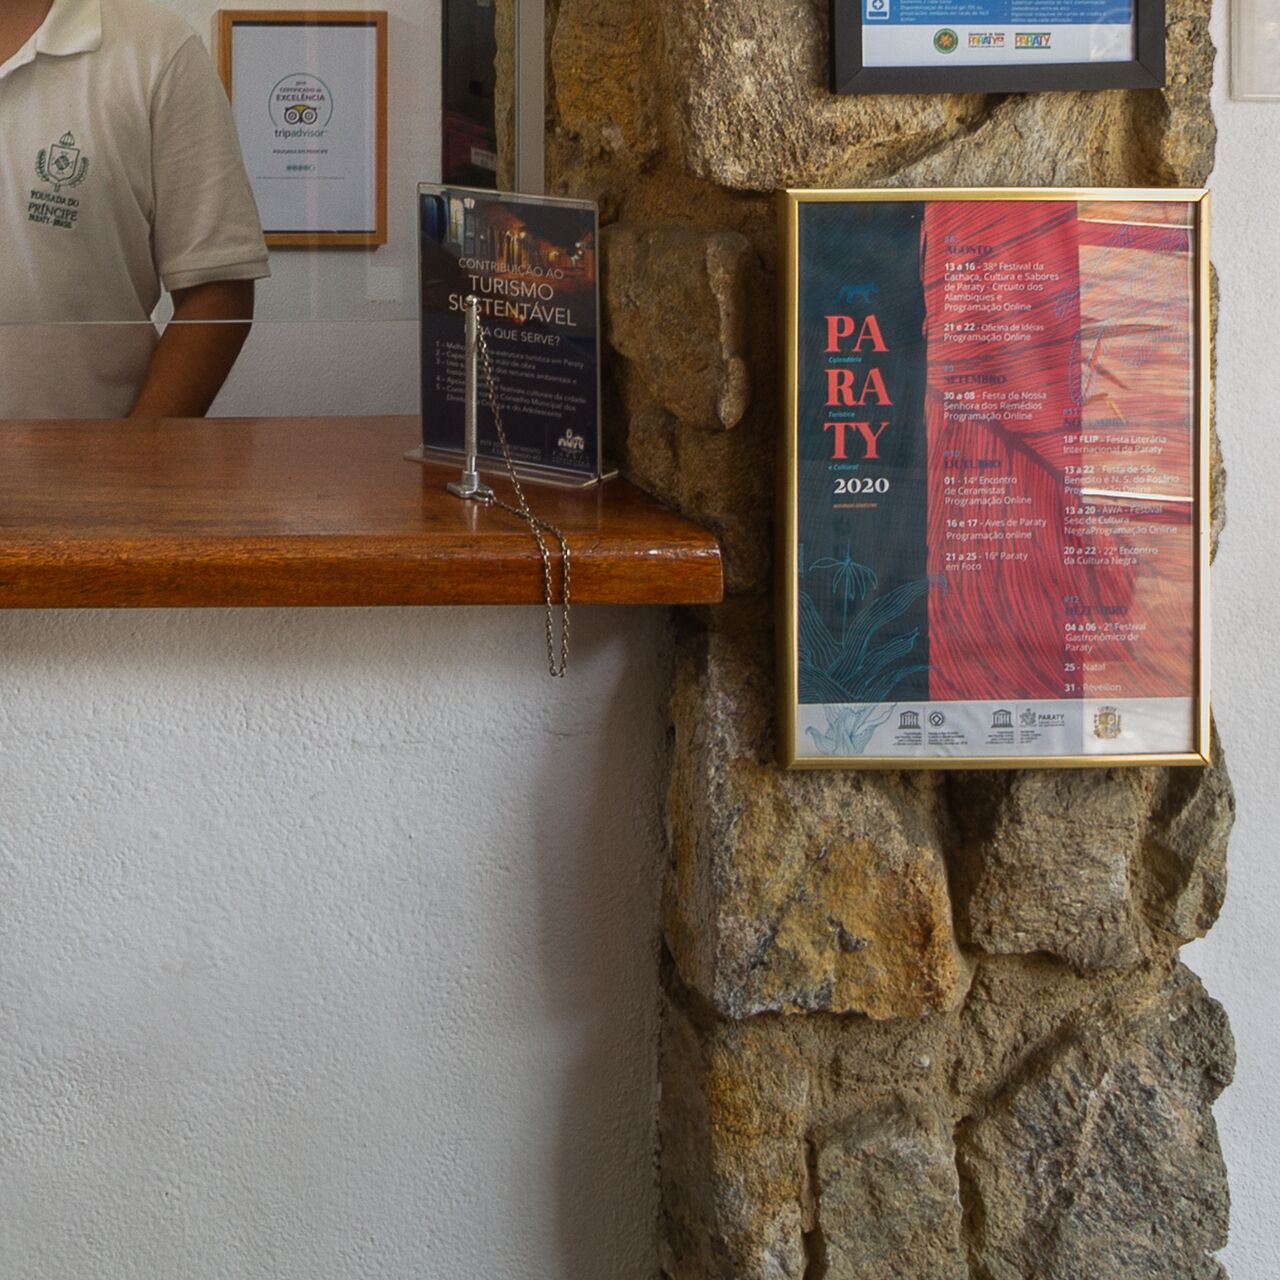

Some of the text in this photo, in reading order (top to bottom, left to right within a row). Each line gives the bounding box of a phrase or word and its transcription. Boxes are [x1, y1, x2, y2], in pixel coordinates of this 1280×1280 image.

[275, 128, 324, 139] tripadvisor
[31, 190, 79, 208] POUSADA DO
[28, 202, 78, 221] PRÍNCIPE
[458, 258, 564, 280] CONTRIBUIÇÃO AO
[983, 273, 1015, 281] Cultura
[1024, 273, 1059, 281] Sabores
[468, 274, 554, 301] TURISMO
[944, 283, 1043, 292] de Paraty Circuito dos
[944, 293, 995, 302] Alambiques
[944, 303, 1032, 313] Programação Online
[494, 328, 518, 341] QUE
[521, 331, 561, 346] SERVE?
[824, 314, 890, 352] PA
[944, 333, 1002, 343] Programação
[824, 368, 894, 406] RA
[944, 402, 1042, 410] Senhora dos Remédios
[944, 412, 1032, 422] Programação Online
[823, 422, 890, 459] TY
[1064, 445, 1120, 454] Internacional
[833, 478, 890, 494] 2020
[944, 487, 1005, 495] de Ceramistas
[944, 497, 1001, 507] Programação
[946, 532, 1003, 541] Programação
[1064, 556, 1137, 566] da Cultura Negra
[1065, 633, 1125, 642] Gastronômico
[1065, 643, 1093, 653] Paraty
[1064, 663, 1105, 672] 25 Natal
